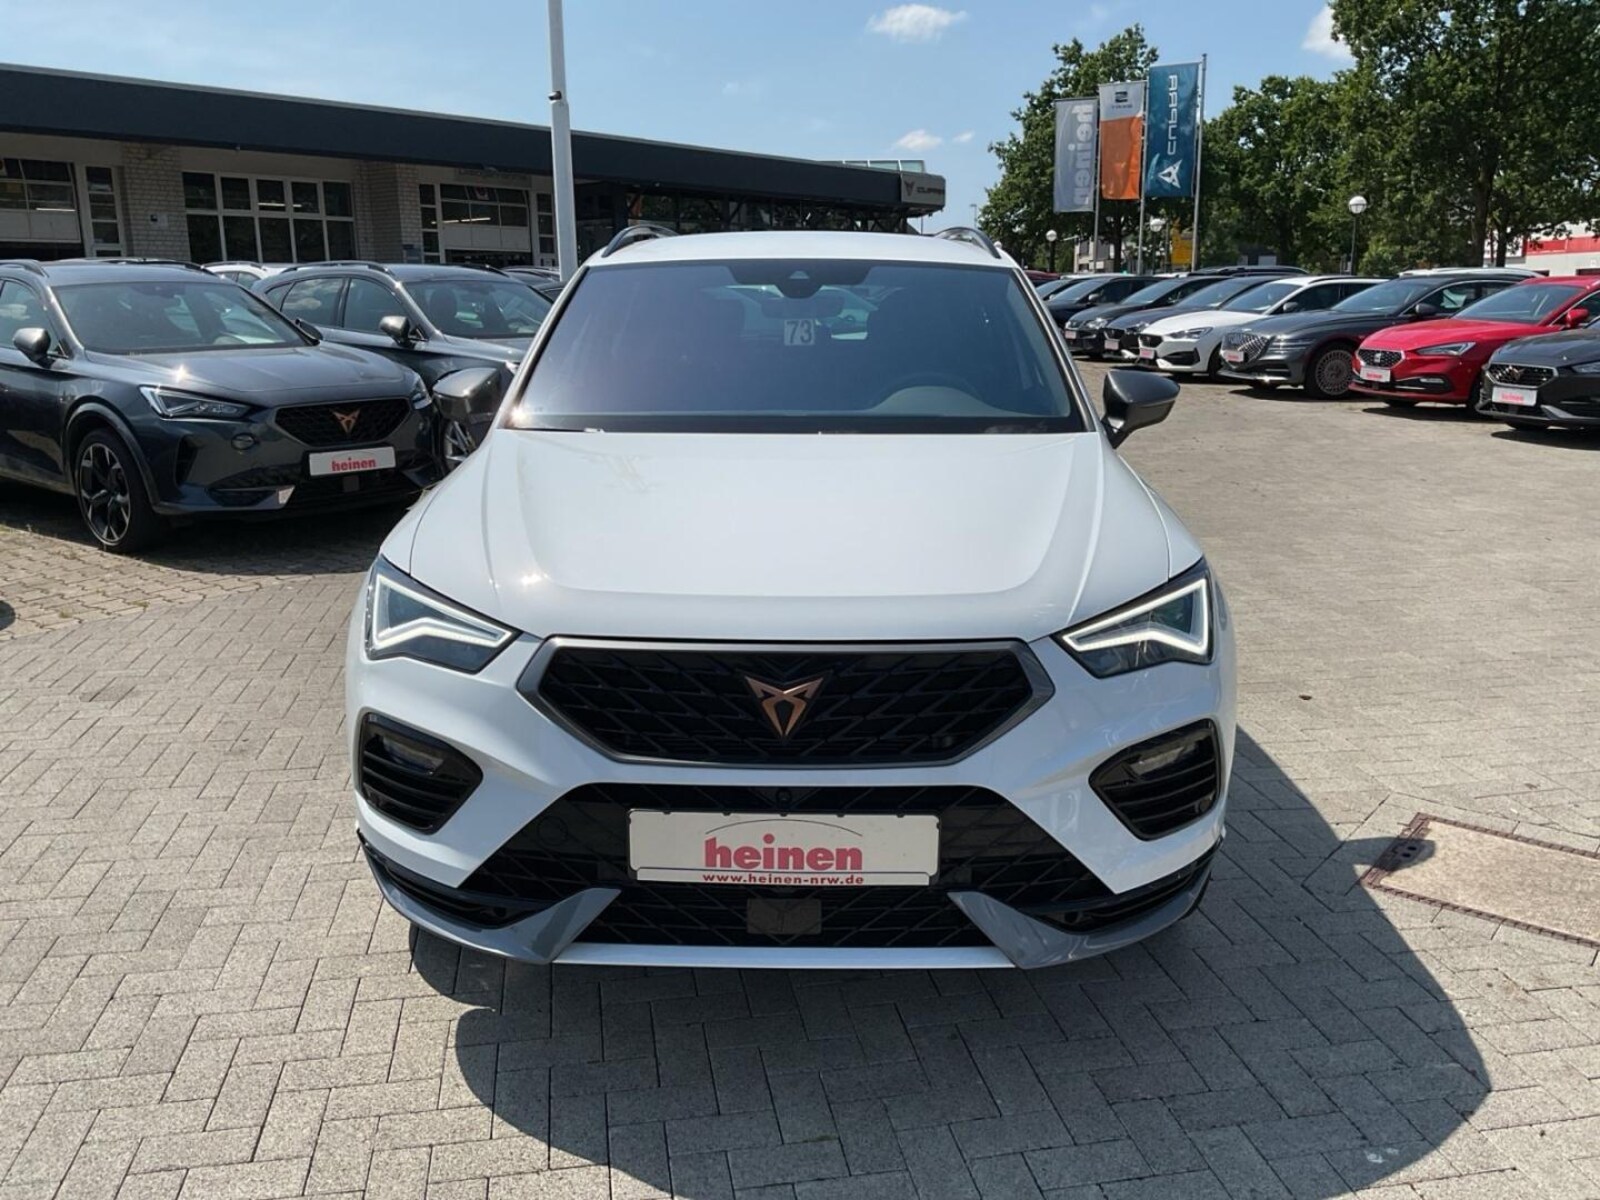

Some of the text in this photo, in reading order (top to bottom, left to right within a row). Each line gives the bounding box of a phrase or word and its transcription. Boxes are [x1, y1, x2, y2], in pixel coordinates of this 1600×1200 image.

[786, 320, 813, 345] 73
[331, 457, 377, 472] heinen
[704, 833, 863, 871] heinen
[702, 873, 864, 885] www.heinen-nrw.de
